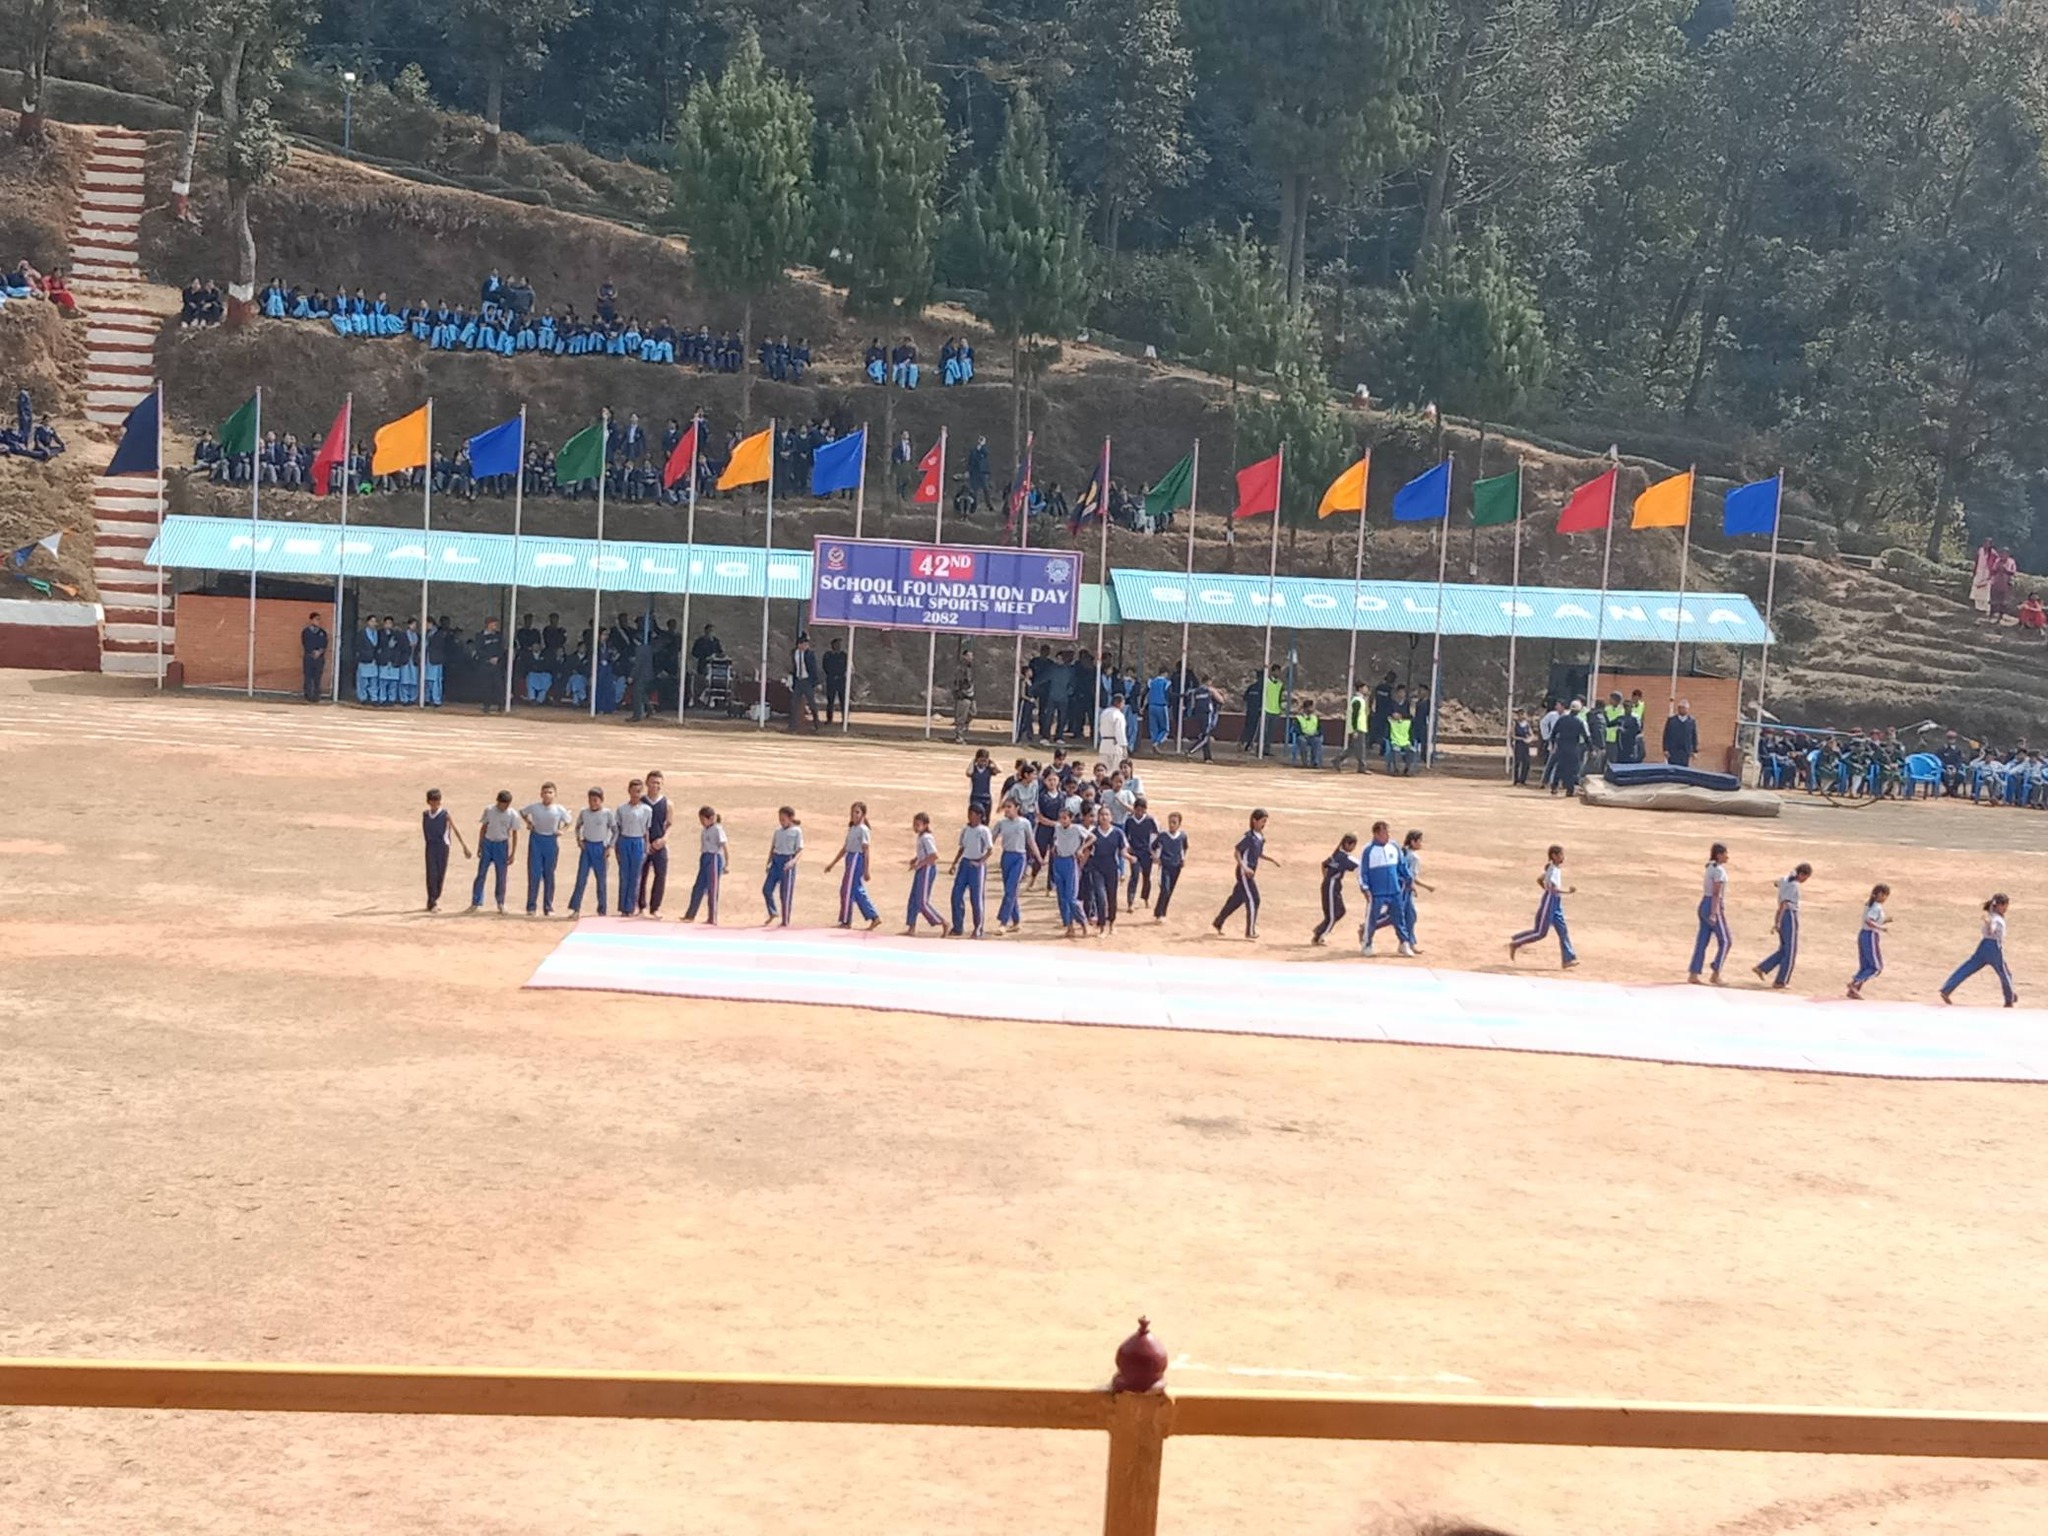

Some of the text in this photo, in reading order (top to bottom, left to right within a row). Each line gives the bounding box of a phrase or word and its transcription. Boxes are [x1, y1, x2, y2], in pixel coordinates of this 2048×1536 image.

[820, 575, 1069, 605] SCHOOL FOUNDATION DAY
[852, 592, 1036, 616] & ANNUAL SPORTS MEET
[922, 611, 959, 626] 2082
